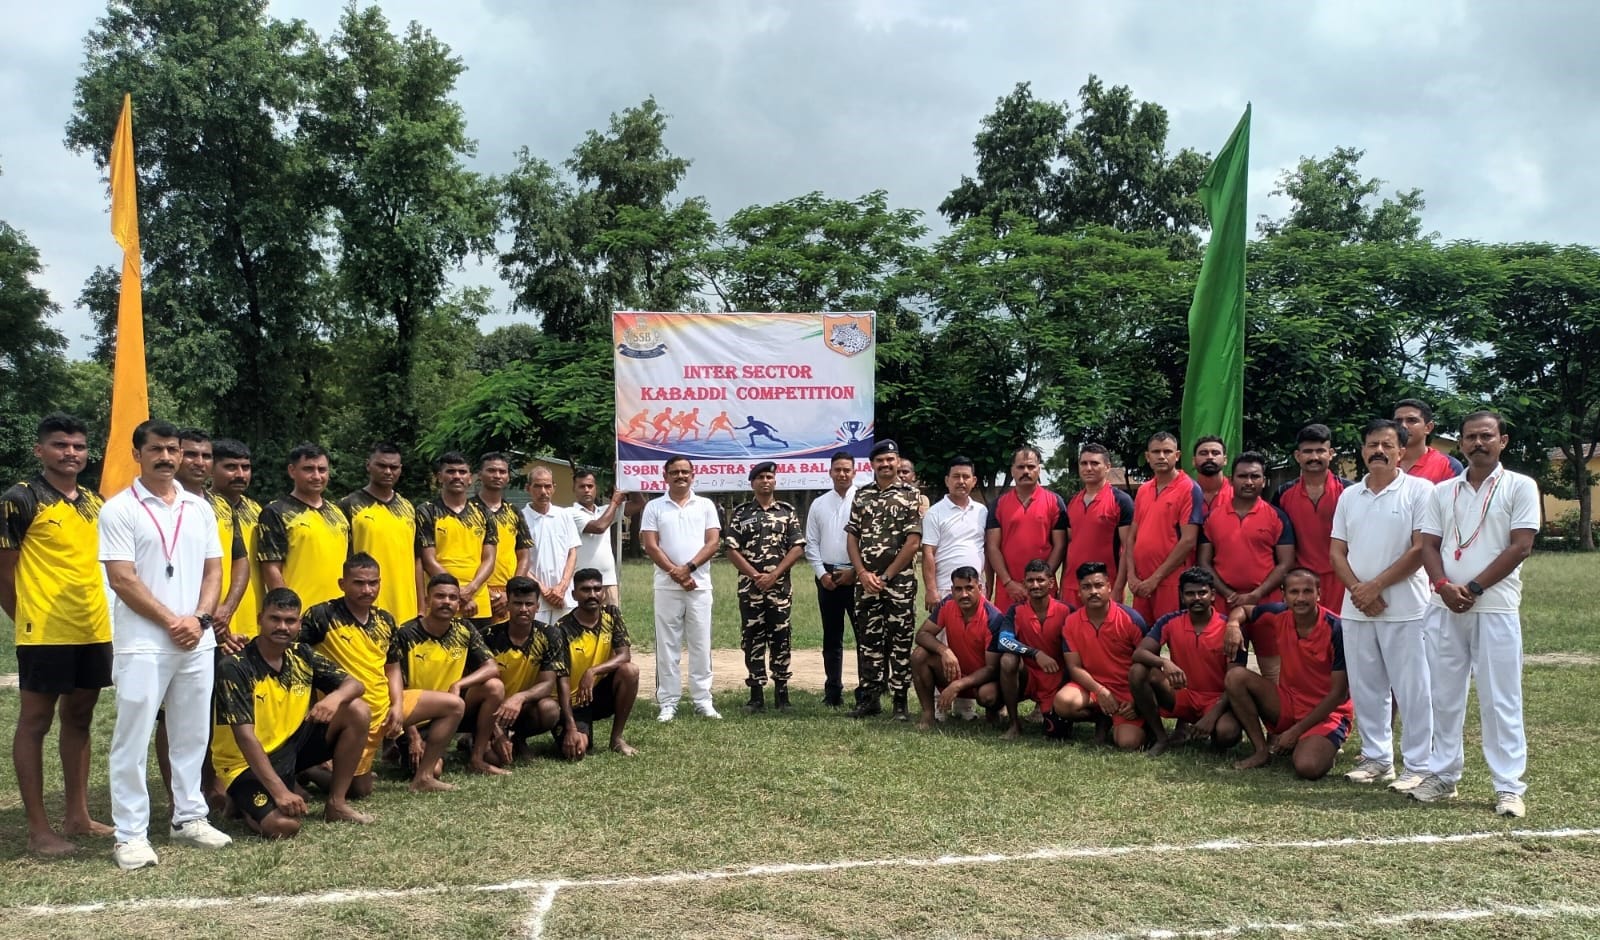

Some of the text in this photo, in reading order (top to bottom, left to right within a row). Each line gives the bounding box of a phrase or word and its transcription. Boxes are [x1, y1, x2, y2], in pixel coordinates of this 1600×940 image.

[633, 332, 651, 342] SSB
[683, 365, 813, 379] INTER SECTOR
[641, 386, 855, 400] KABADDI COMPETITION
[800, 463, 828, 473] BAL
